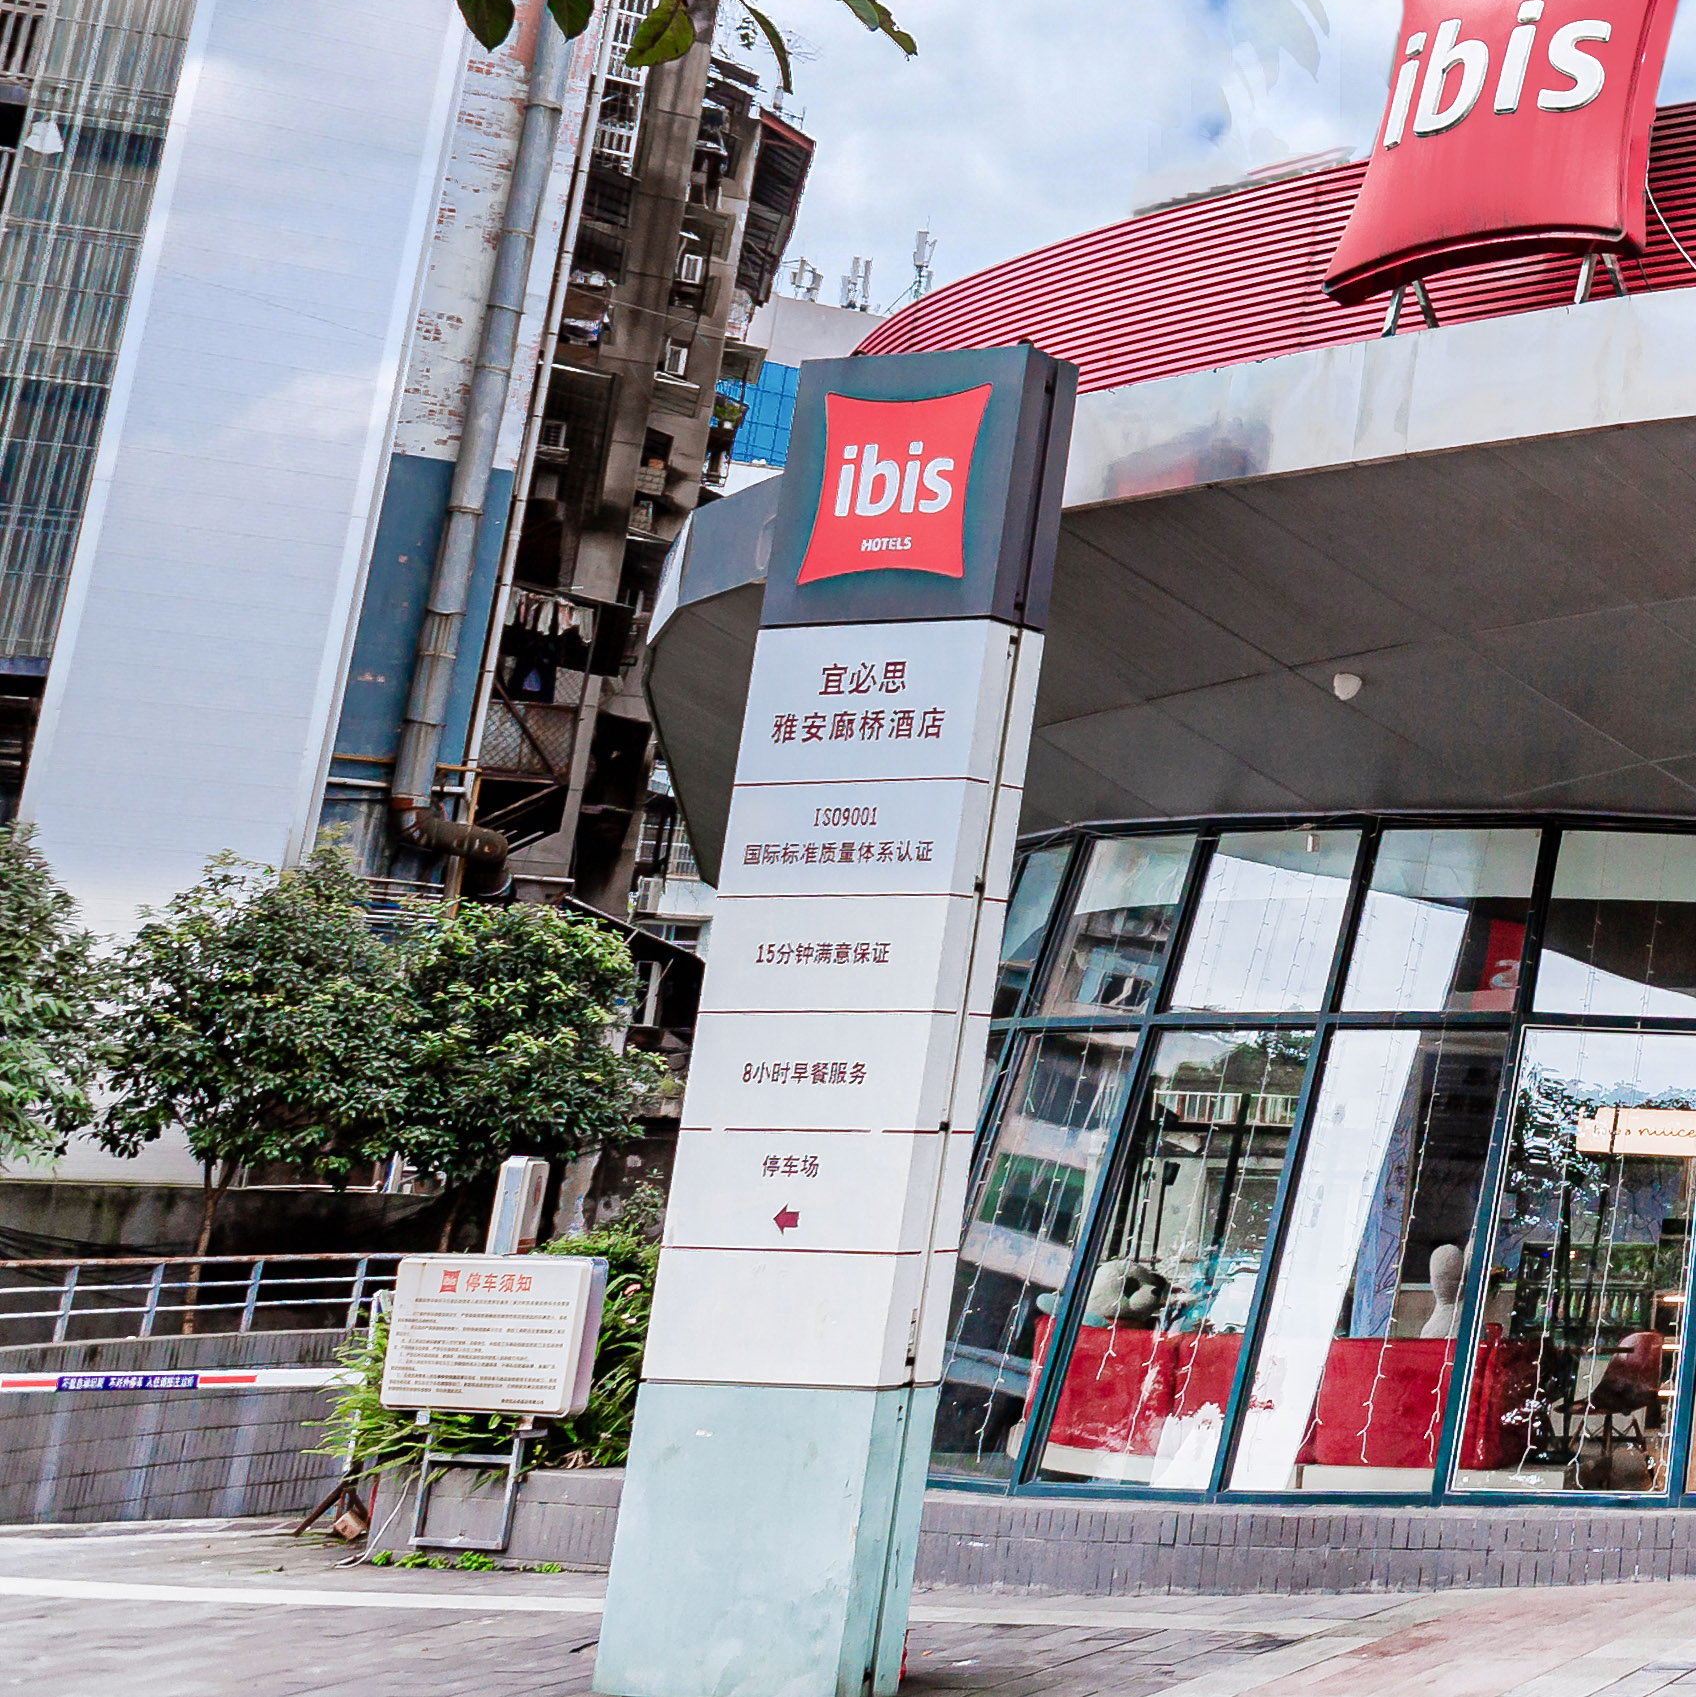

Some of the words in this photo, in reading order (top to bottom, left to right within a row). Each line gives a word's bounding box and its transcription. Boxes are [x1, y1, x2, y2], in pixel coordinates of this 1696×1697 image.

[1383, 0, 1611, 150] ibis
[834, 440, 954, 517] ibis
[860, 536, 912, 552] HOTELS
[818, 660, 907, 696] 宜必思
[770, 706, 946, 745] 雅安廊桥酒店
[743, 840, 934, 866] 国际标准质量体系认证
[755, 941, 891, 965] 15分钟满意保证
[742, 1061, 867, 1085] 8小时早餐服务
[762, 1154, 820, 1179] 停车场
[465, 1272, 533, 1293] 停车须知
